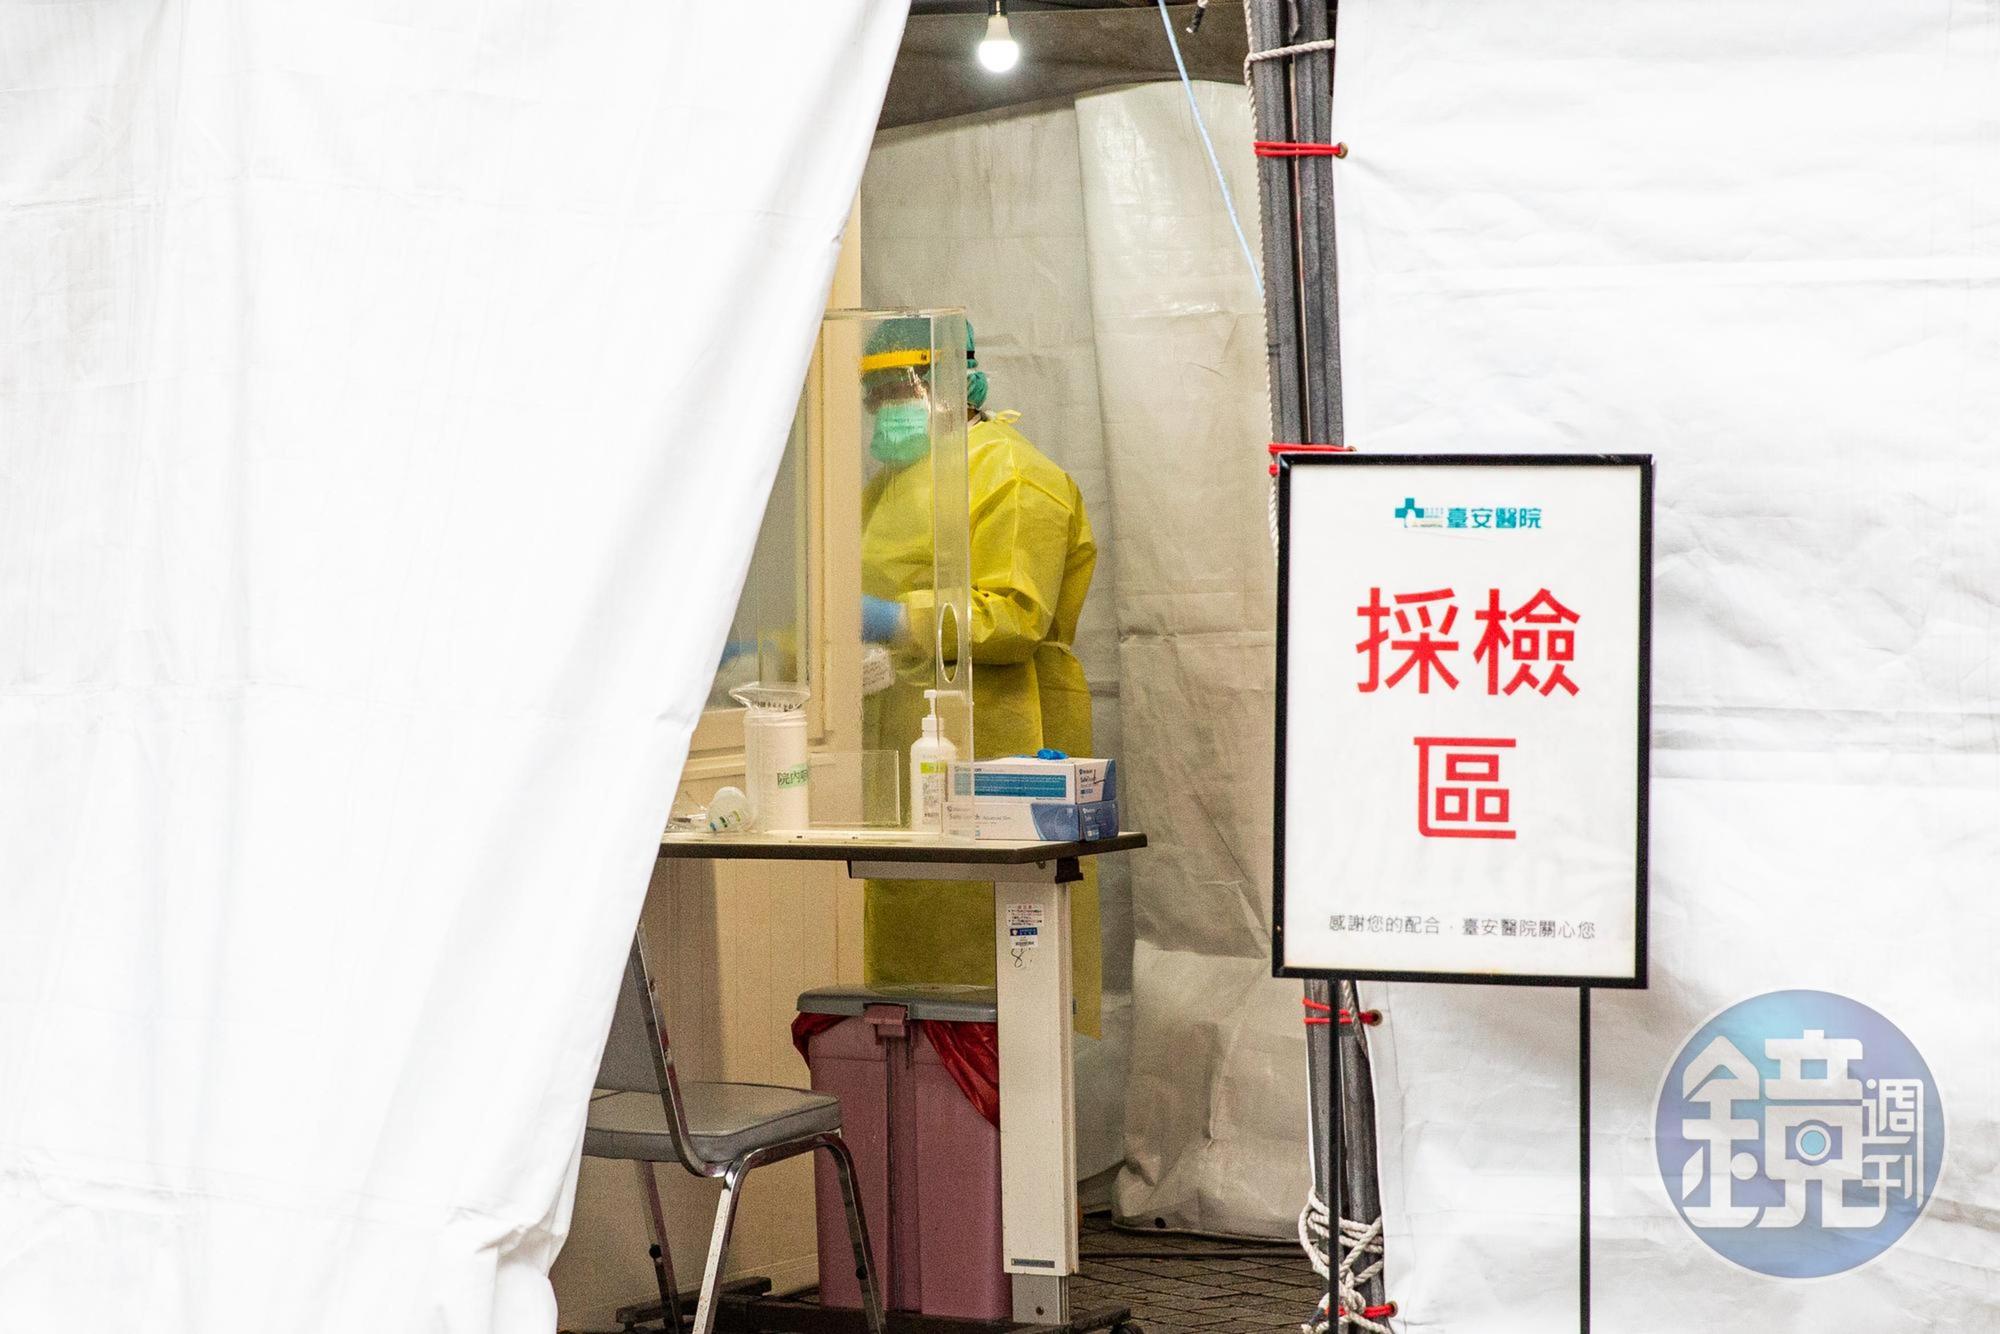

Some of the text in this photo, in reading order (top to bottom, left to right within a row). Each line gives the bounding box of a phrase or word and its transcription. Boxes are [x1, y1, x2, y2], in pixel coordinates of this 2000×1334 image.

[1447, 507, 1541, 529] 臺安醫院
[1356, 587, 1580, 696] 採檢
[1413, 737, 1516, 839] 區
